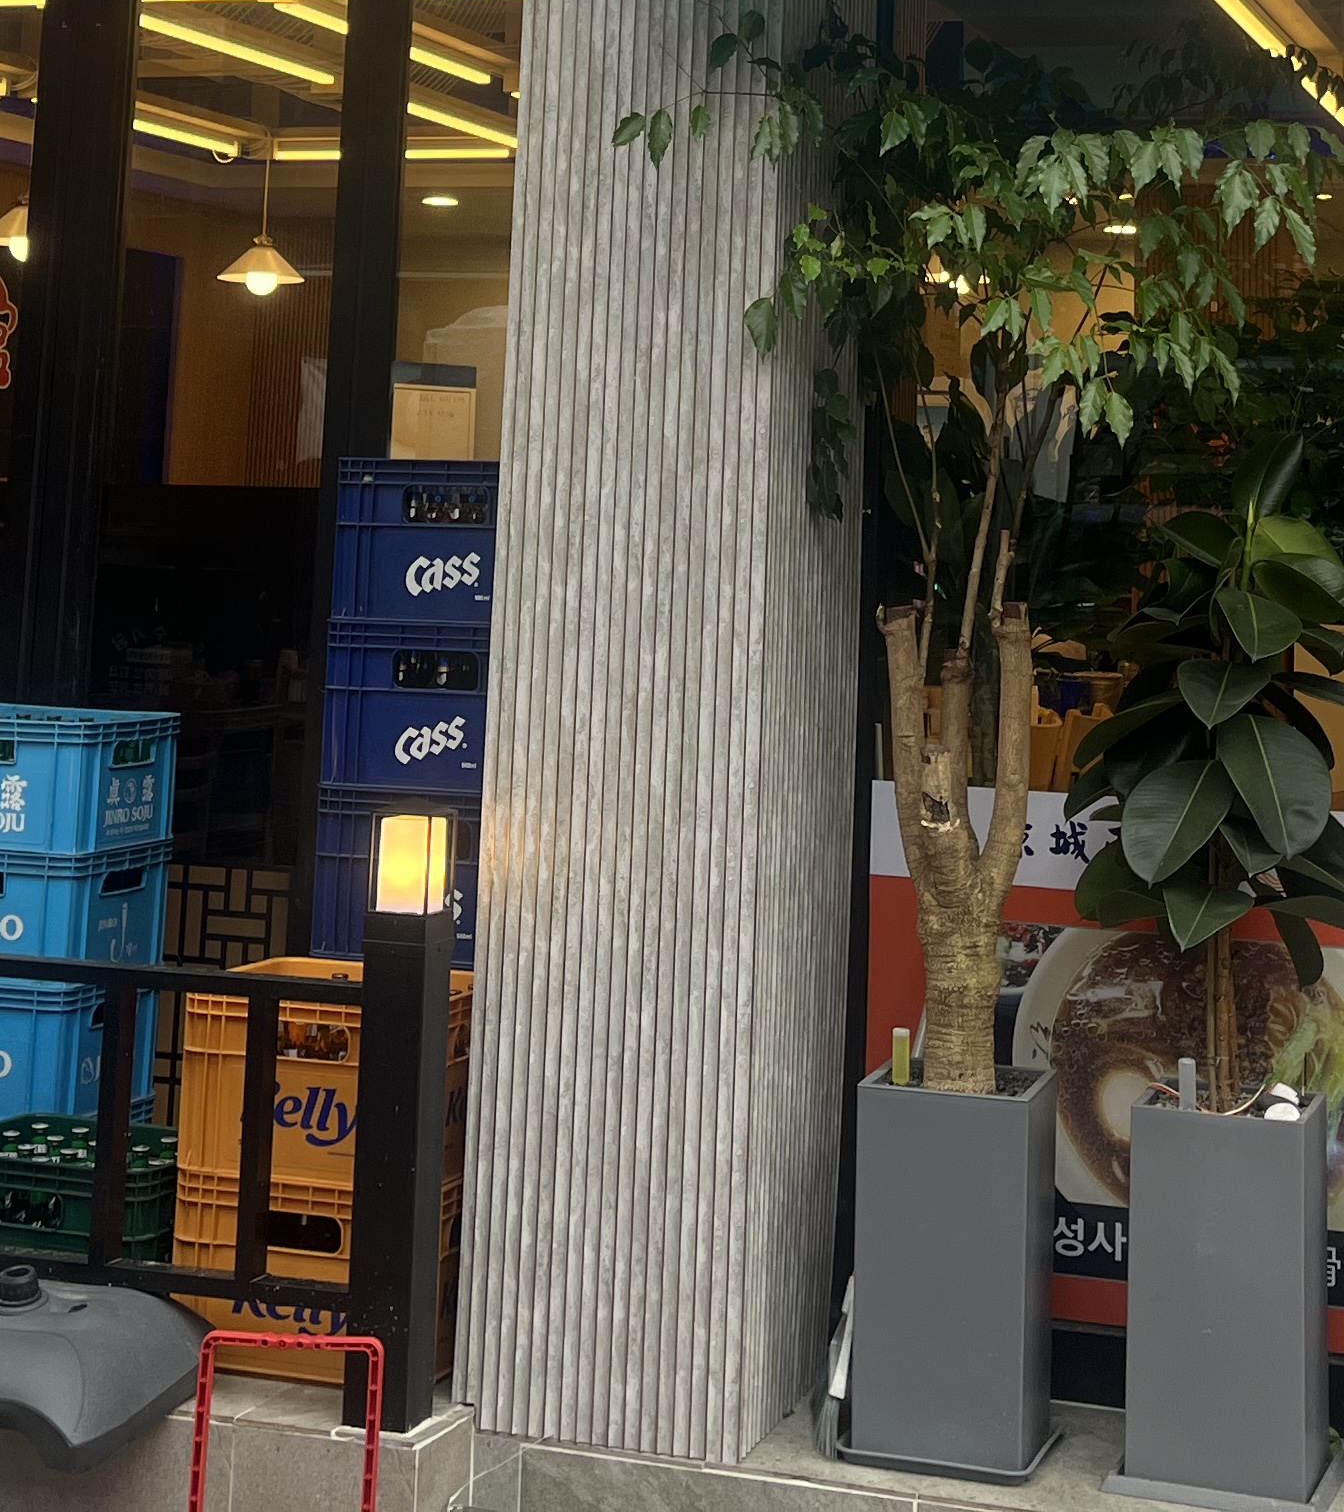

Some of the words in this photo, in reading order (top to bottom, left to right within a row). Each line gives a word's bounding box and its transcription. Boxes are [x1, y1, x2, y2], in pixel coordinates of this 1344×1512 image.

[103, 808, 129, 827] JINRO
[131, 804, 153, 822] SOJU
[273, 1081, 356, 1146] elly
